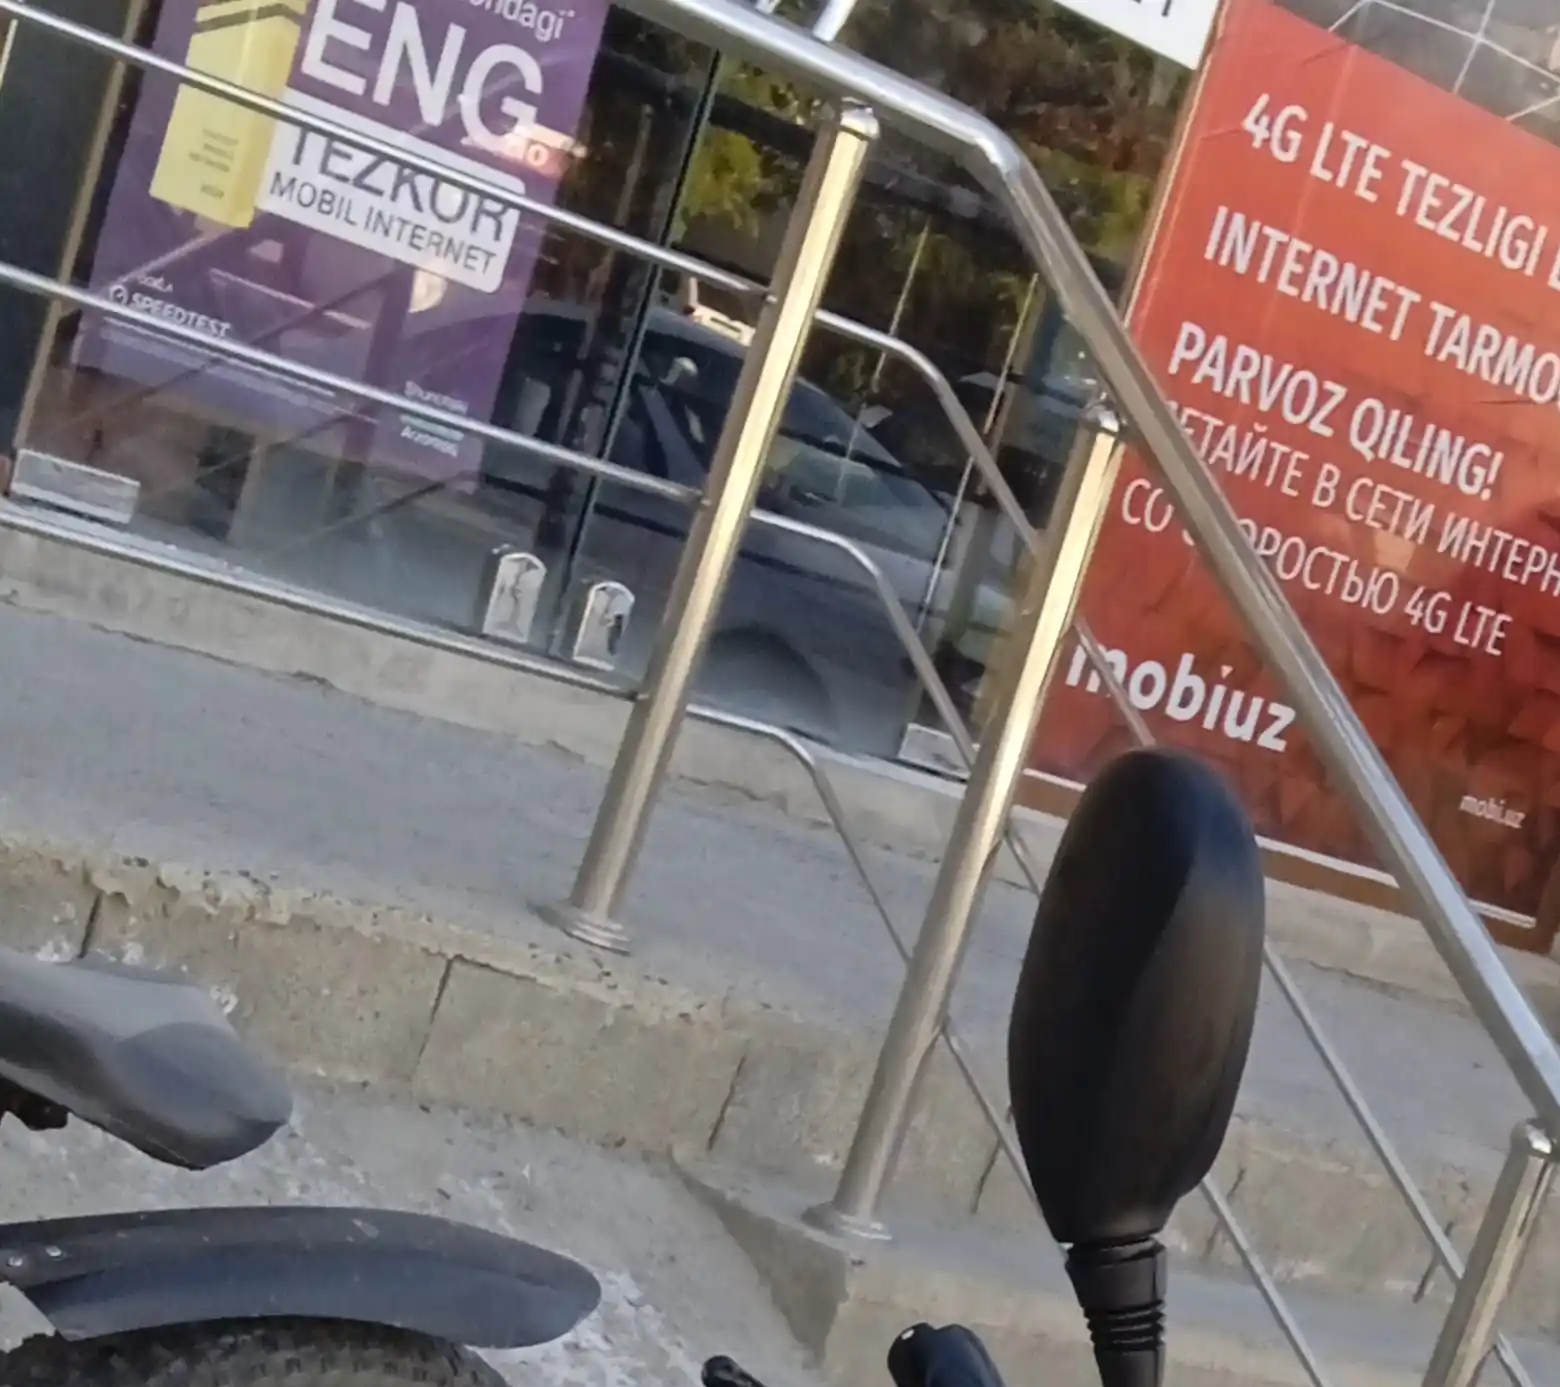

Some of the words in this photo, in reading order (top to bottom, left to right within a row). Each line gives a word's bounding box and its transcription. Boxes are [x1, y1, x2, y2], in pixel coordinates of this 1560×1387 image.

[301, 0, 544, 160] ENG
[269, 171, 358, 227] MOBIL
[363, 205, 498, 276] INTERNET
[1241, 93, 1308, 163] 4G
[1309, 122, 1391, 203] LTE
[1396, 159, 1547, 276] TEZLIGI
[1204, 205, 1421, 341] INTERNET
[1166, 400, 1310, 498] ЕТАЙТЕ
[1311, 463, 1342, 508] В
[1346, 478, 1436, 545] СЕТИ
[1168, 321, 1348, 438] PARVOZ
[1350, 398, 1505, 501] QILING!
[1405, 585, 1452, 634] 4G
[1454, 602, 1514, 657] LTE
[1065, 643, 1297, 753] mobiuz
